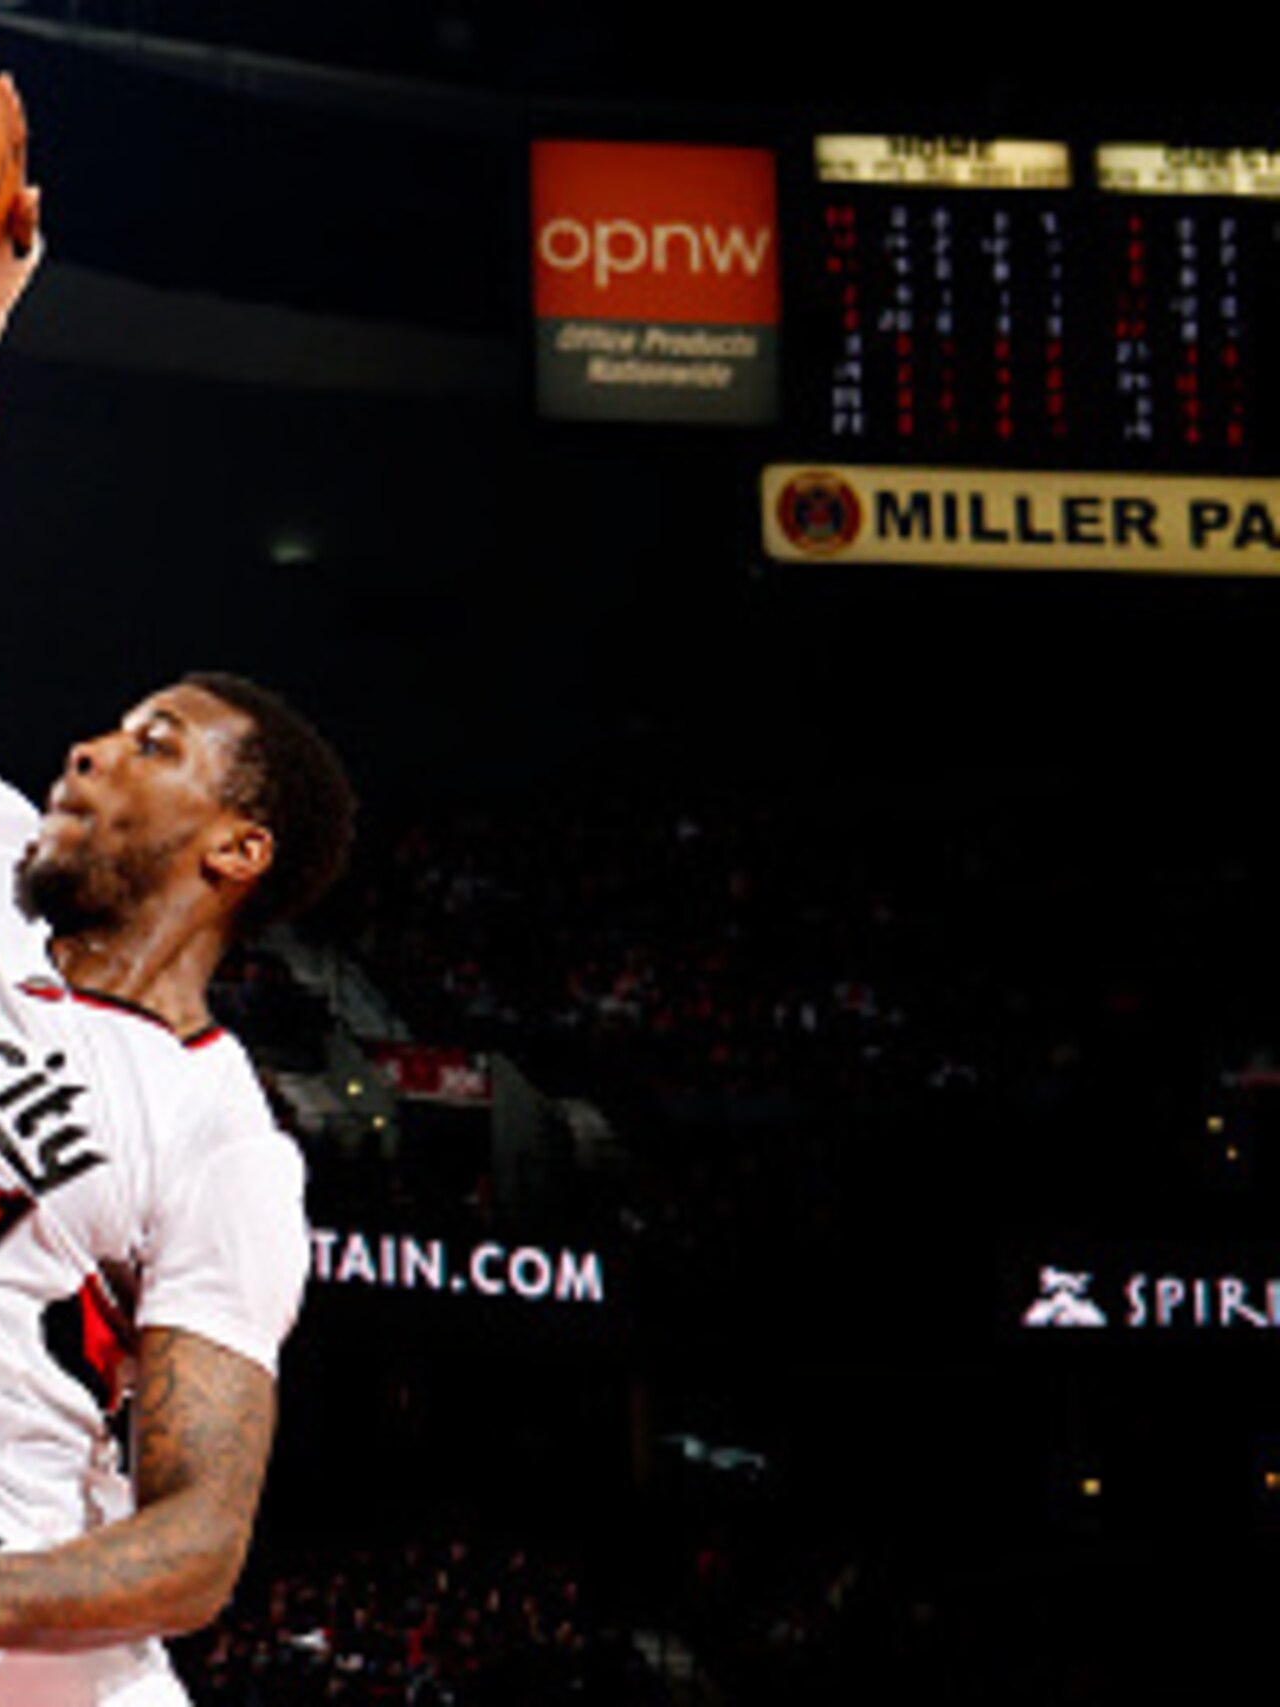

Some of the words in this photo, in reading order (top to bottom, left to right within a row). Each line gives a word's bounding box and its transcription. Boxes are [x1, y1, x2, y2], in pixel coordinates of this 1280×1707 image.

[539, 217, 769, 288] opnw
[643, 328, 757, 357] Products
[874, 491, 1161, 548] MILLER
[1188, 500, 1280, 550] PA
[309, 1229, 603, 1301] TAIN.COM
